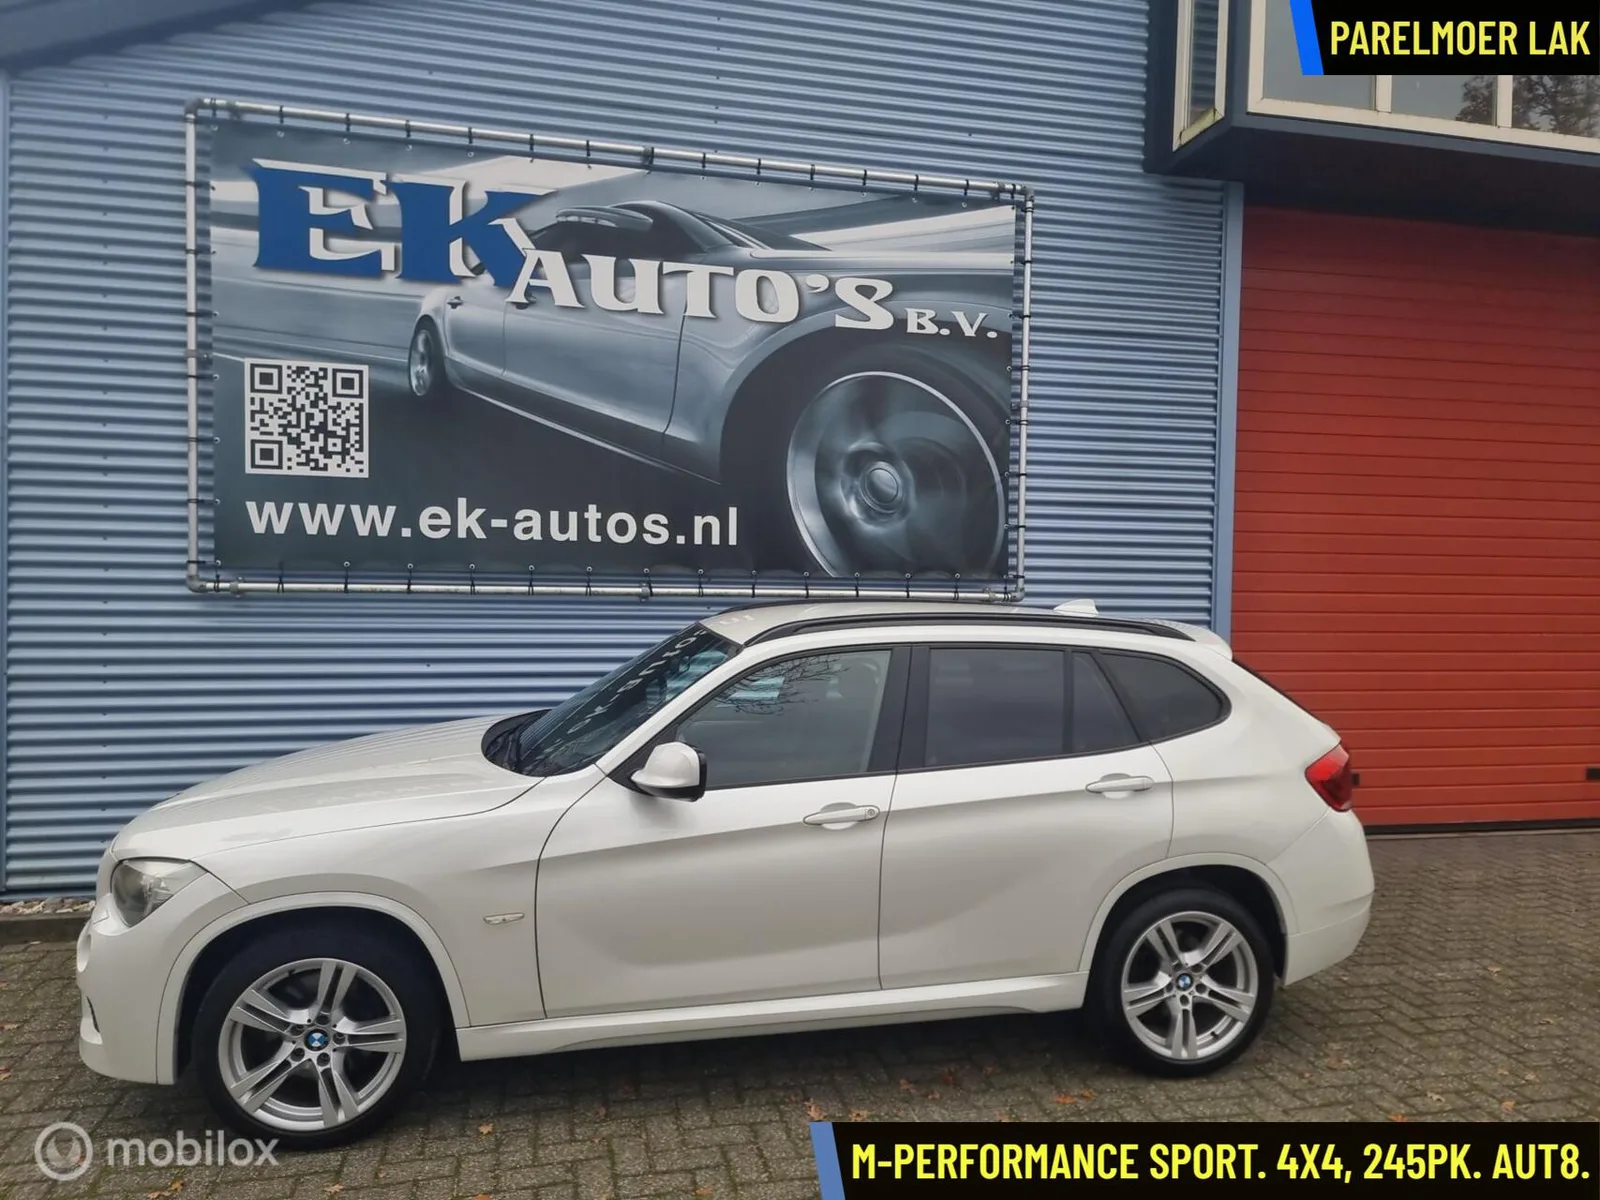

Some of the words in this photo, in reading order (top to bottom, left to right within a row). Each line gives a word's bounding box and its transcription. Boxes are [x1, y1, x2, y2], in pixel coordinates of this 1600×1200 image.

[246, 157, 558, 289] EK
[905, 307, 998, 339] B.V.
[245, 497, 738, 546] www.ek-autos.nl
